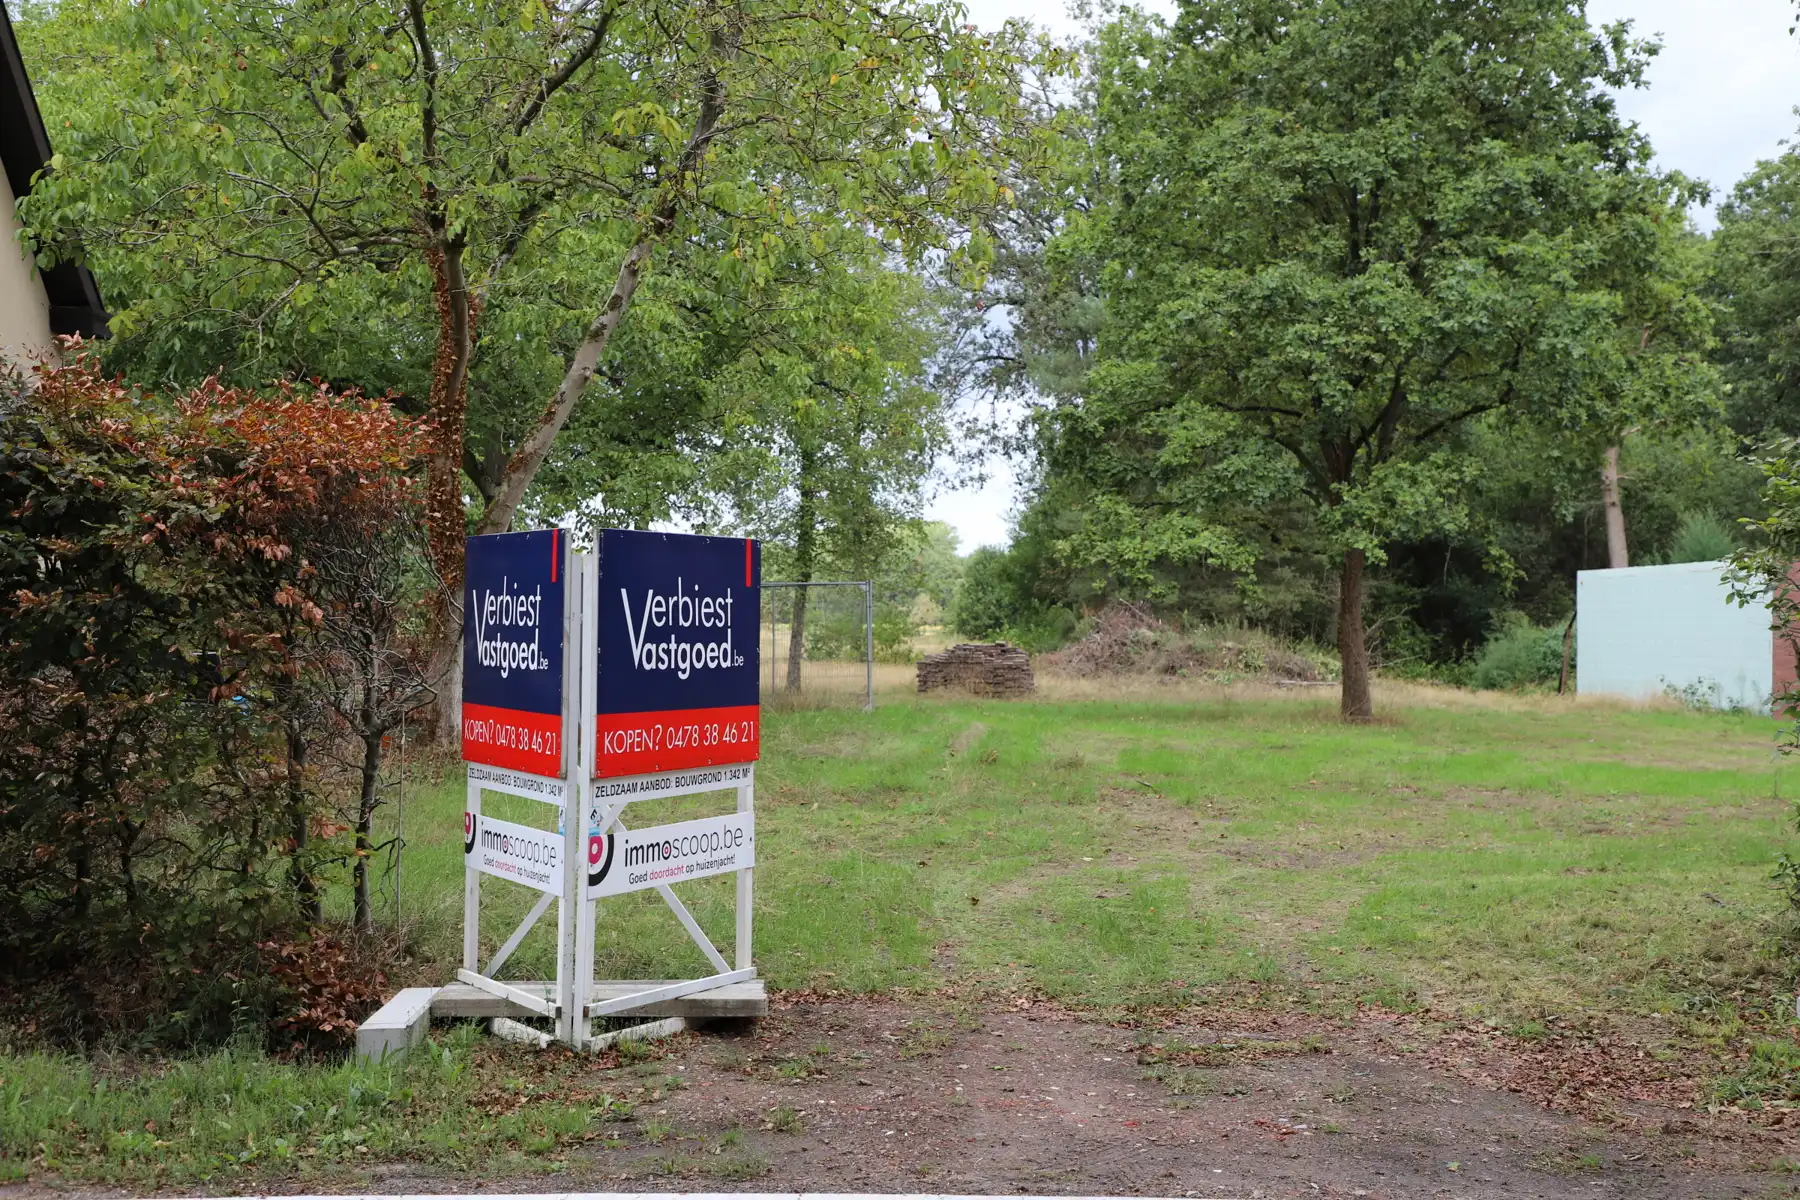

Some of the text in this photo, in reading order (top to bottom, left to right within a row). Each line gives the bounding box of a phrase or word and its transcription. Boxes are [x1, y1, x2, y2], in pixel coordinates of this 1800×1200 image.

[473, 576, 541, 627] Verbiest
[621, 577, 733, 629] Verbiest
[465, 719, 556, 755] KOPEN? 0478 38 46 21
[604, 721, 754, 755] KOPEN? 0478 38 46 21
[469, 767, 492, 782] ZELDZAAM
[492, 772, 513, 787] AANBOD:
[513, 776, 544, 793] BOUWGROND
[595, 781, 638, 798] ZELDZAAM
[639, 776, 673, 793] AANBOD:
[675, 771, 723, 788] BOUWGROND
[724, 768, 741, 781] 1.342
[481, 821, 556, 868] immoscoop.be
[624, 824, 744, 868] immoscoop.be
[483, 854, 551, 884] Goed doordacht op huizenjacht!
[629, 854, 736, 885] Goed doordacht op huizenjacht!
